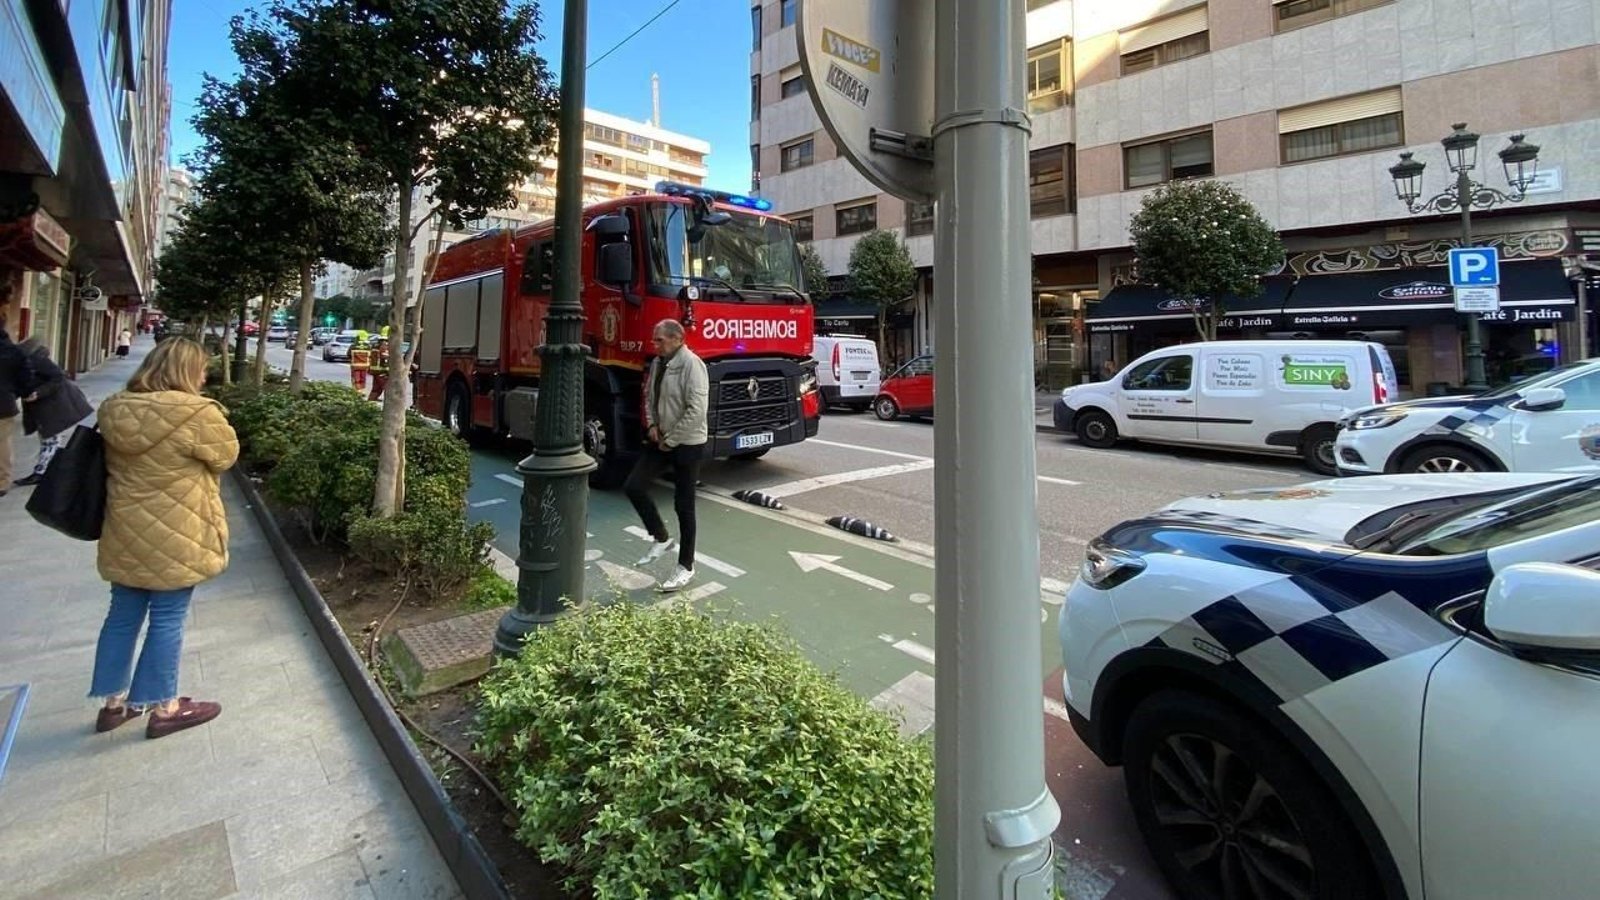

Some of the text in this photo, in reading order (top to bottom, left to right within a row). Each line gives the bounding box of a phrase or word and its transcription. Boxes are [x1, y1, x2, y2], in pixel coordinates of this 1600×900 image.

[1459, 253, 1487, 282] P
[1216, 318, 1234, 327] afé
[1292, 369, 1335, 381] SINY
